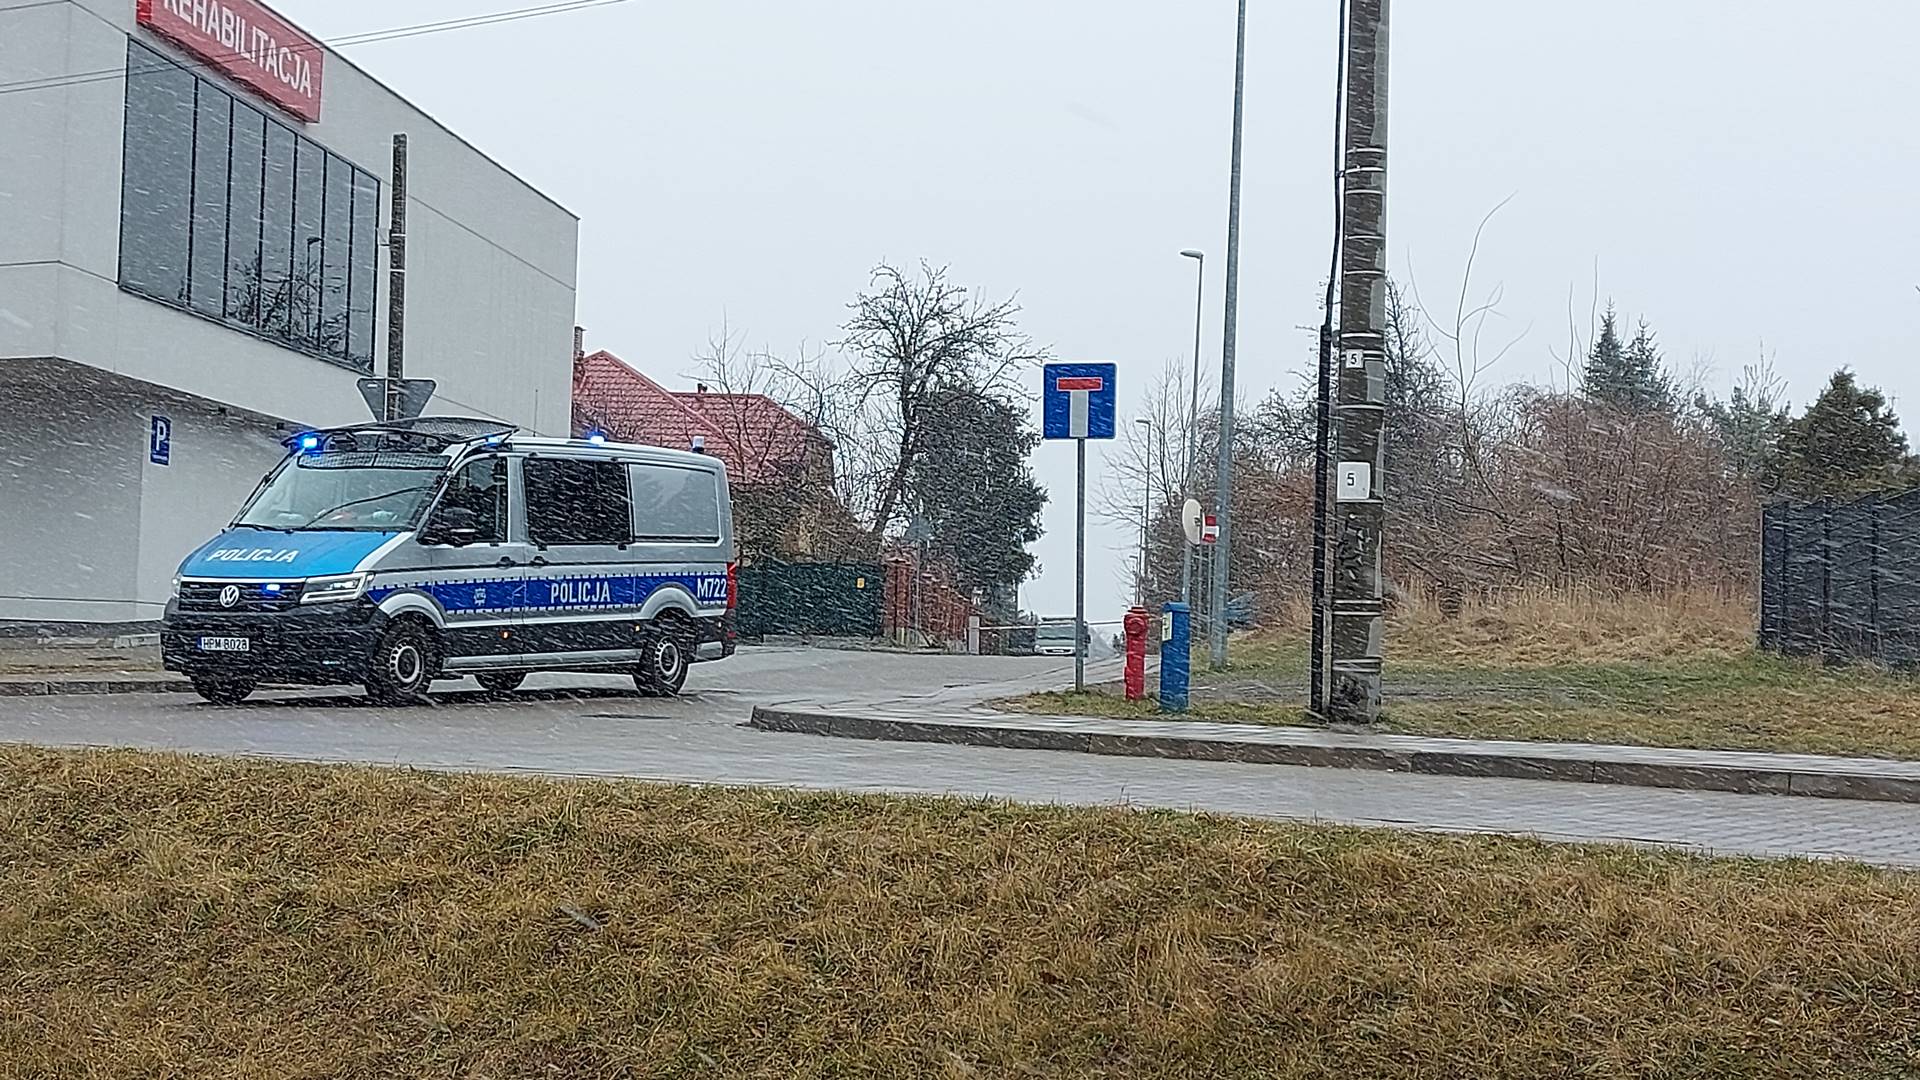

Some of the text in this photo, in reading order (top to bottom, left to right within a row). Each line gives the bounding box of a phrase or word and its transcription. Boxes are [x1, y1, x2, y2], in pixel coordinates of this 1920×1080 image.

[1350, 353, 1357, 365] 5
[156, 420, 167, 451] P
[1347, 472, 1355, 486] 5
[206, 548, 300, 563] POLICJA
[550, 581, 611, 604] POLICJA
[697, 577, 727, 598] M722
